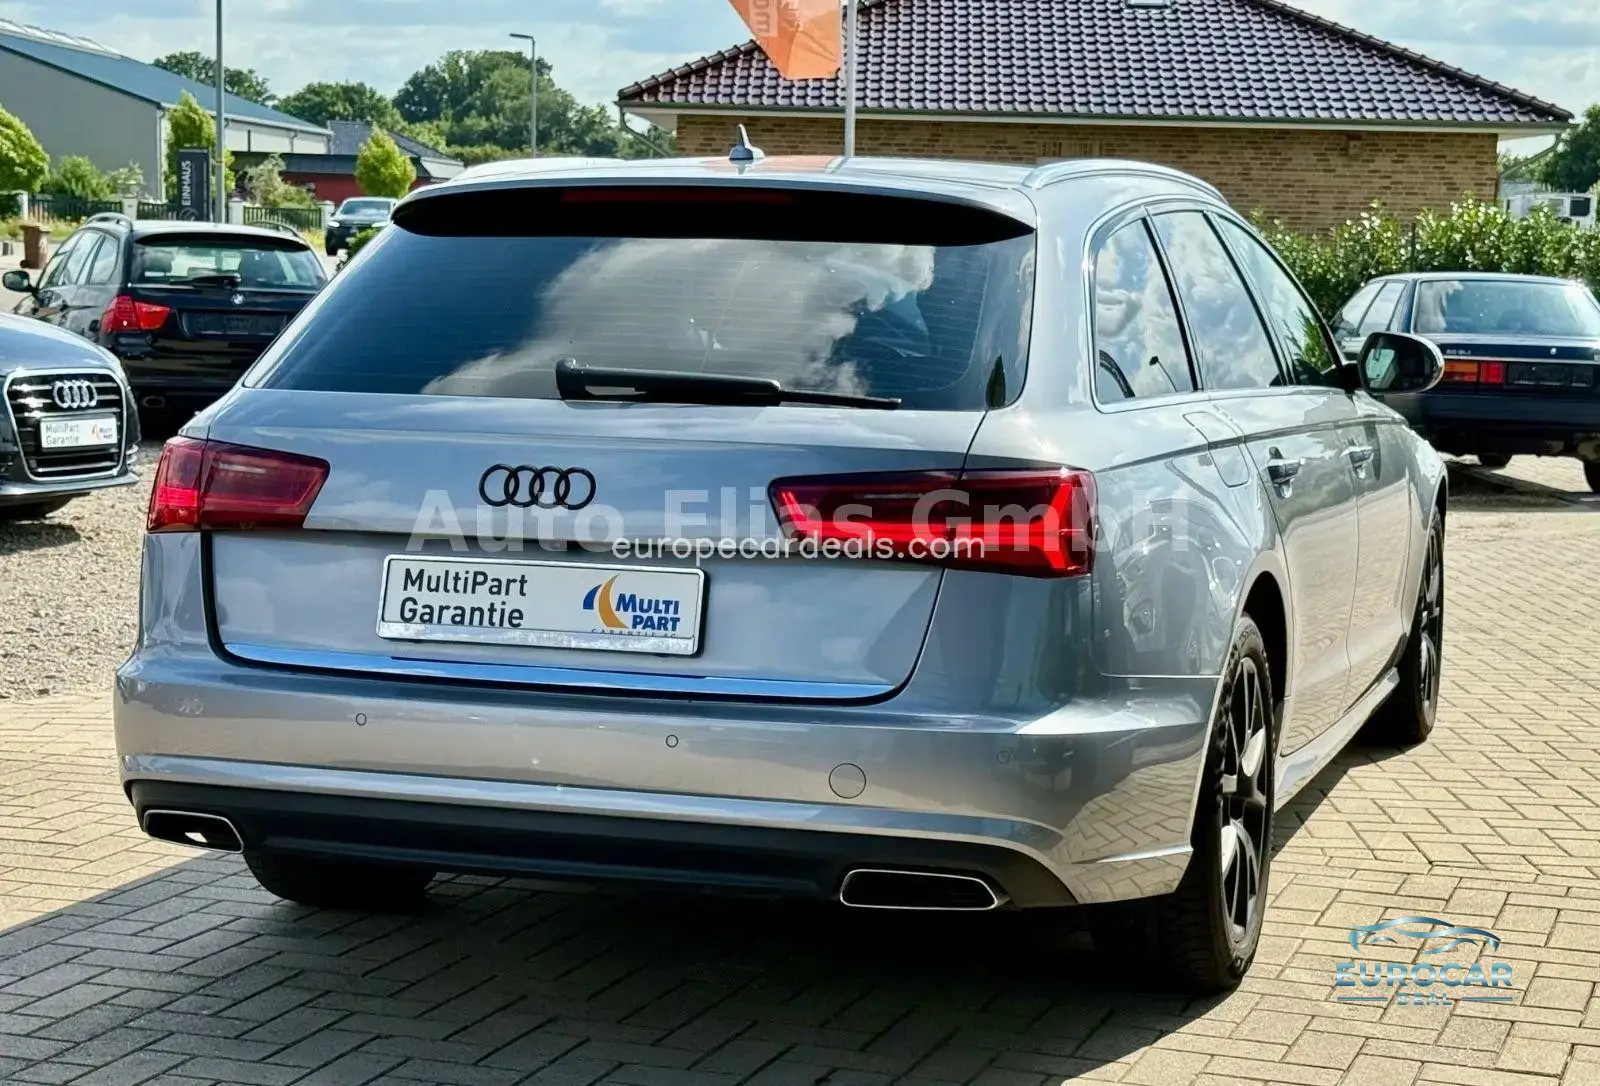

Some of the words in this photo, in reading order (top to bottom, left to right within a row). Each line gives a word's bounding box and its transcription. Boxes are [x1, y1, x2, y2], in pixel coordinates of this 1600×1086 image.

[181, 160, 191, 206] EINHAUS
[403, 568, 528, 597] MultiPart
[400, 597, 525, 628] Garantie
[615, 593, 679, 615] MULTI
[632, 614, 681, 631] PART
